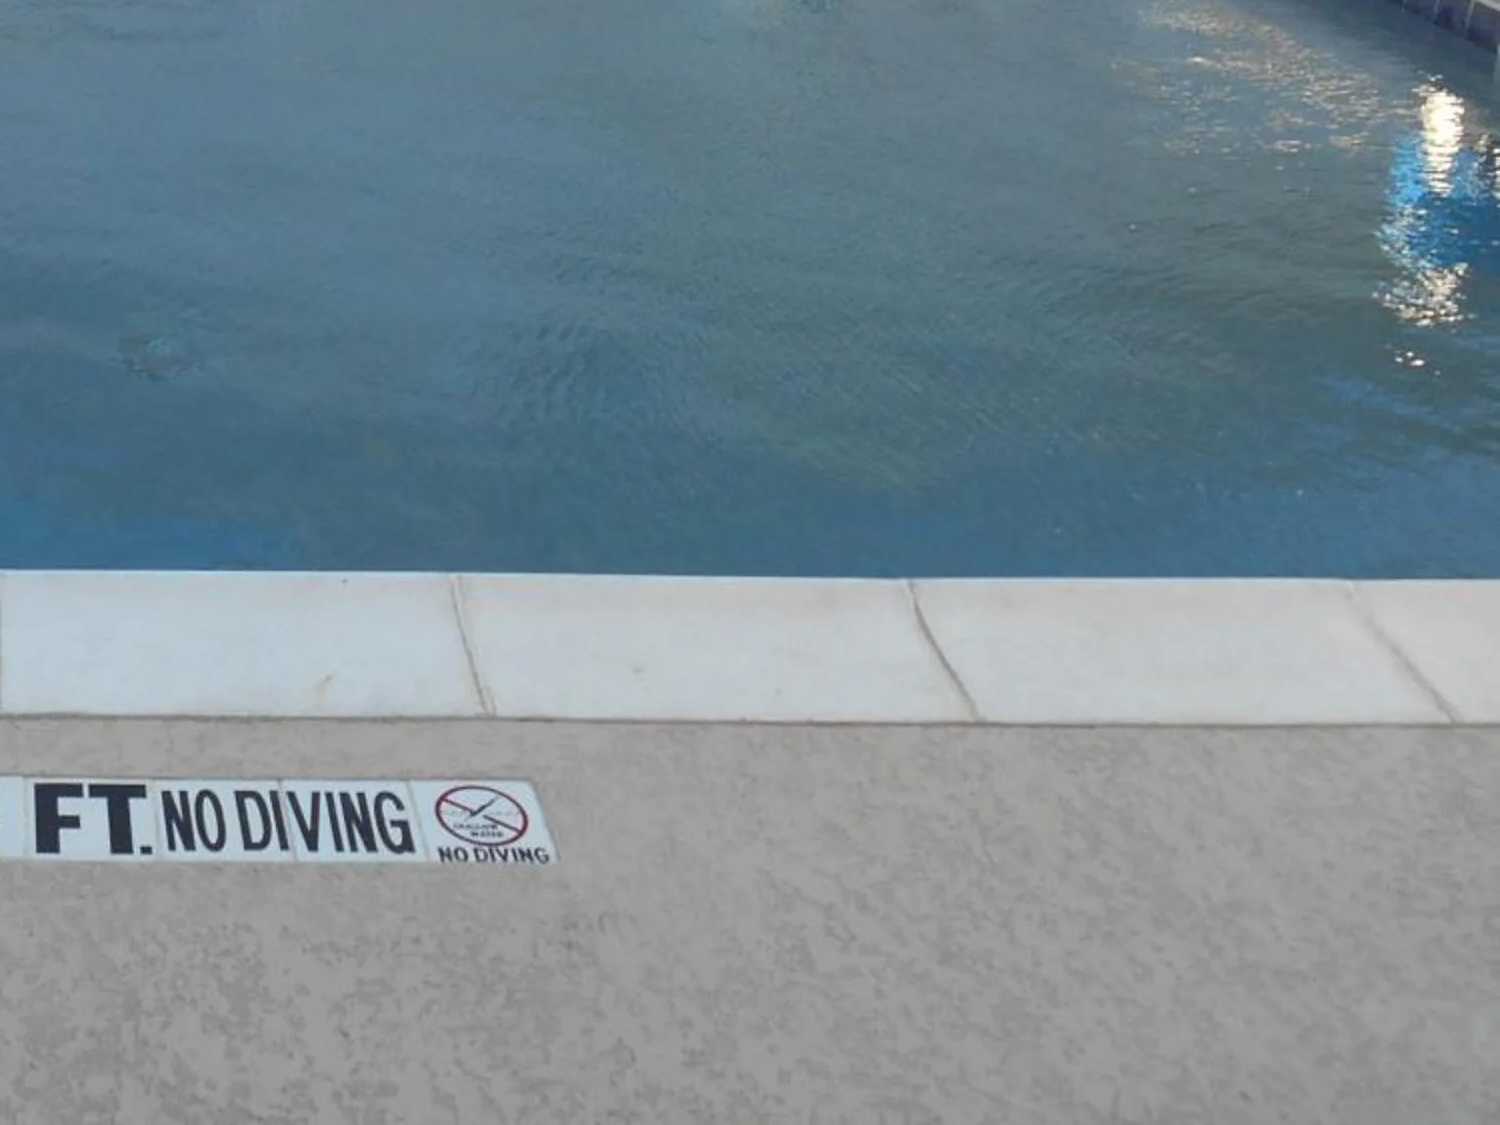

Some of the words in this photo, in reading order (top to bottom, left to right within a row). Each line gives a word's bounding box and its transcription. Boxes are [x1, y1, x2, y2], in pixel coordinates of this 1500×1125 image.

[33, 782, 153, 855] FT.
[160, 789, 227, 853] NO
[234, 790, 417, 854] DIVING
[437, 846, 470, 863] NO
[473, 847, 551, 865] DIVING
